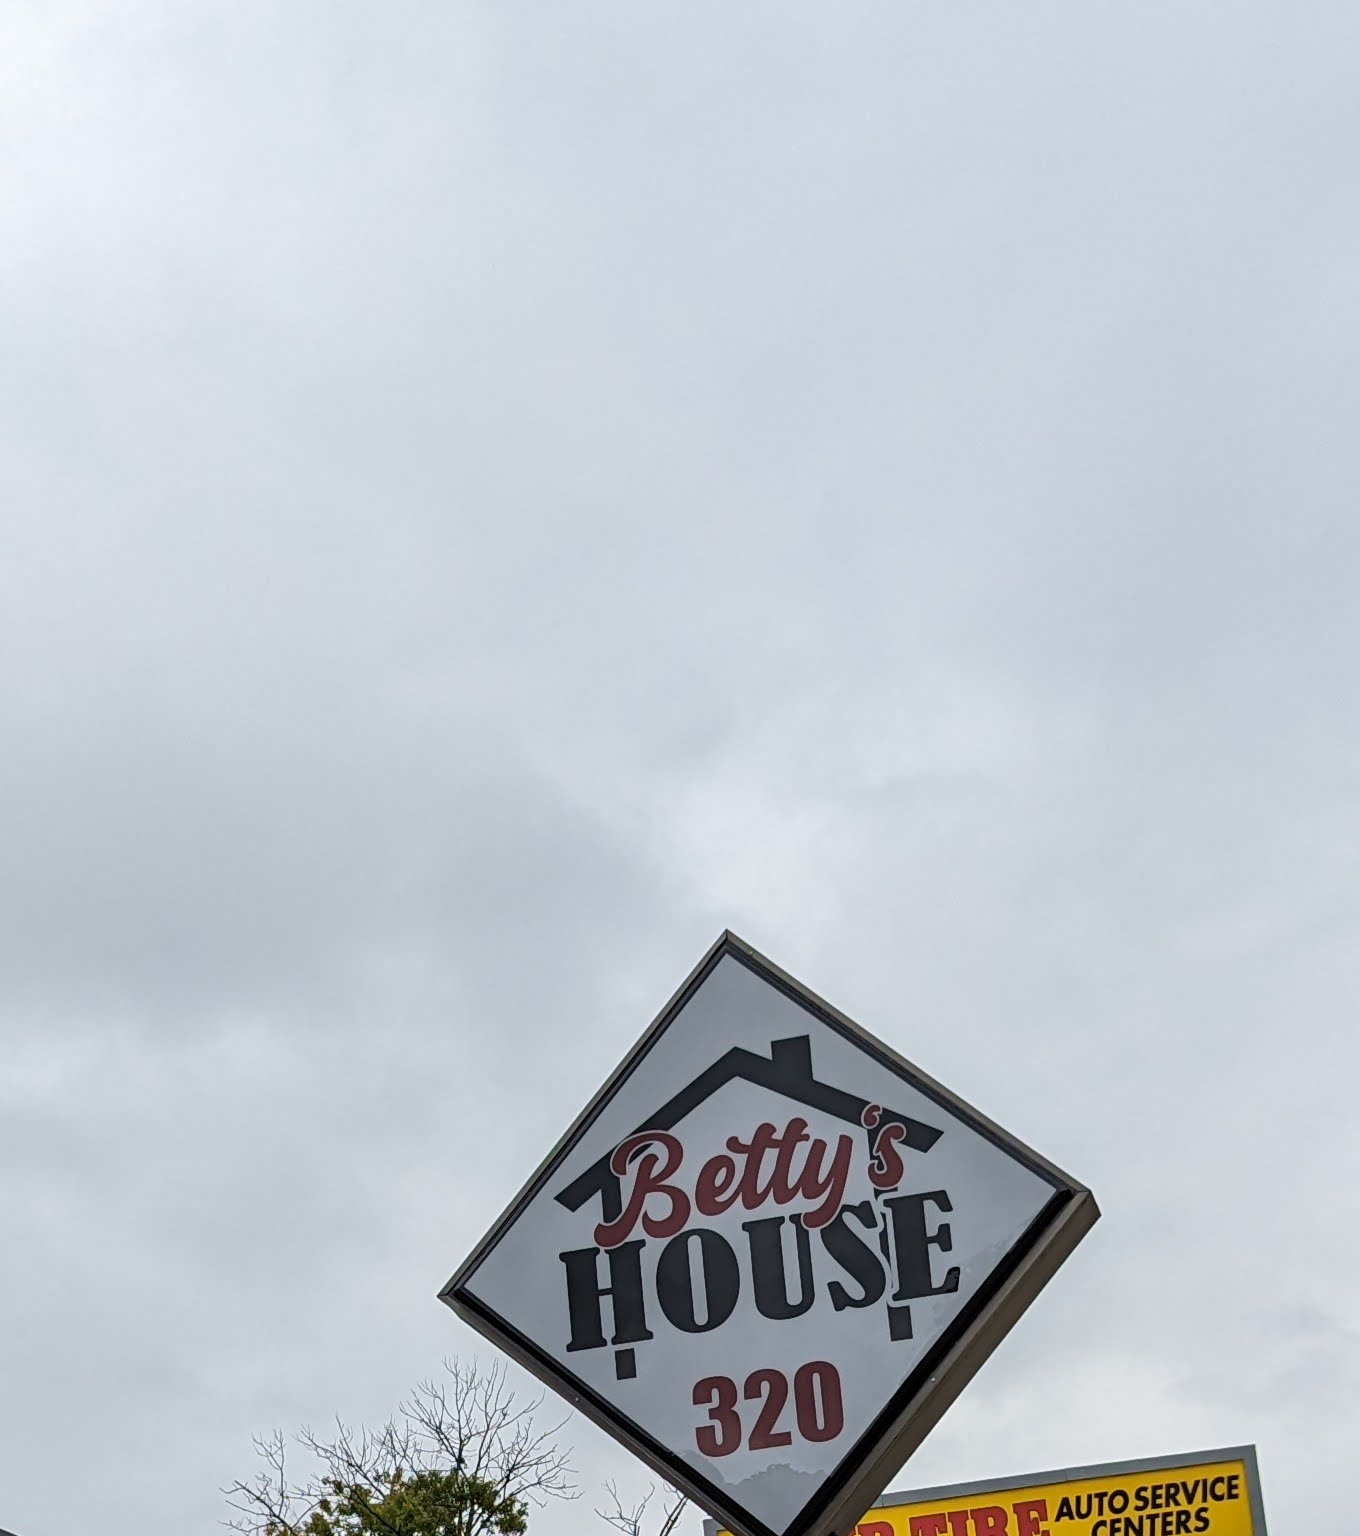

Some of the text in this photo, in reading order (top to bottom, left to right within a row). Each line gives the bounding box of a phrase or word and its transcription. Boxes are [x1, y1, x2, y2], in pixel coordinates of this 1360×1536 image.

[593, 1103, 906, 1248] Betty's
[559, 1189, 960, 1353] HOUSE
[692, 1360, 844, 1458] 320
[1054, 1474, 1239, 1523] AUTO SERVICE
